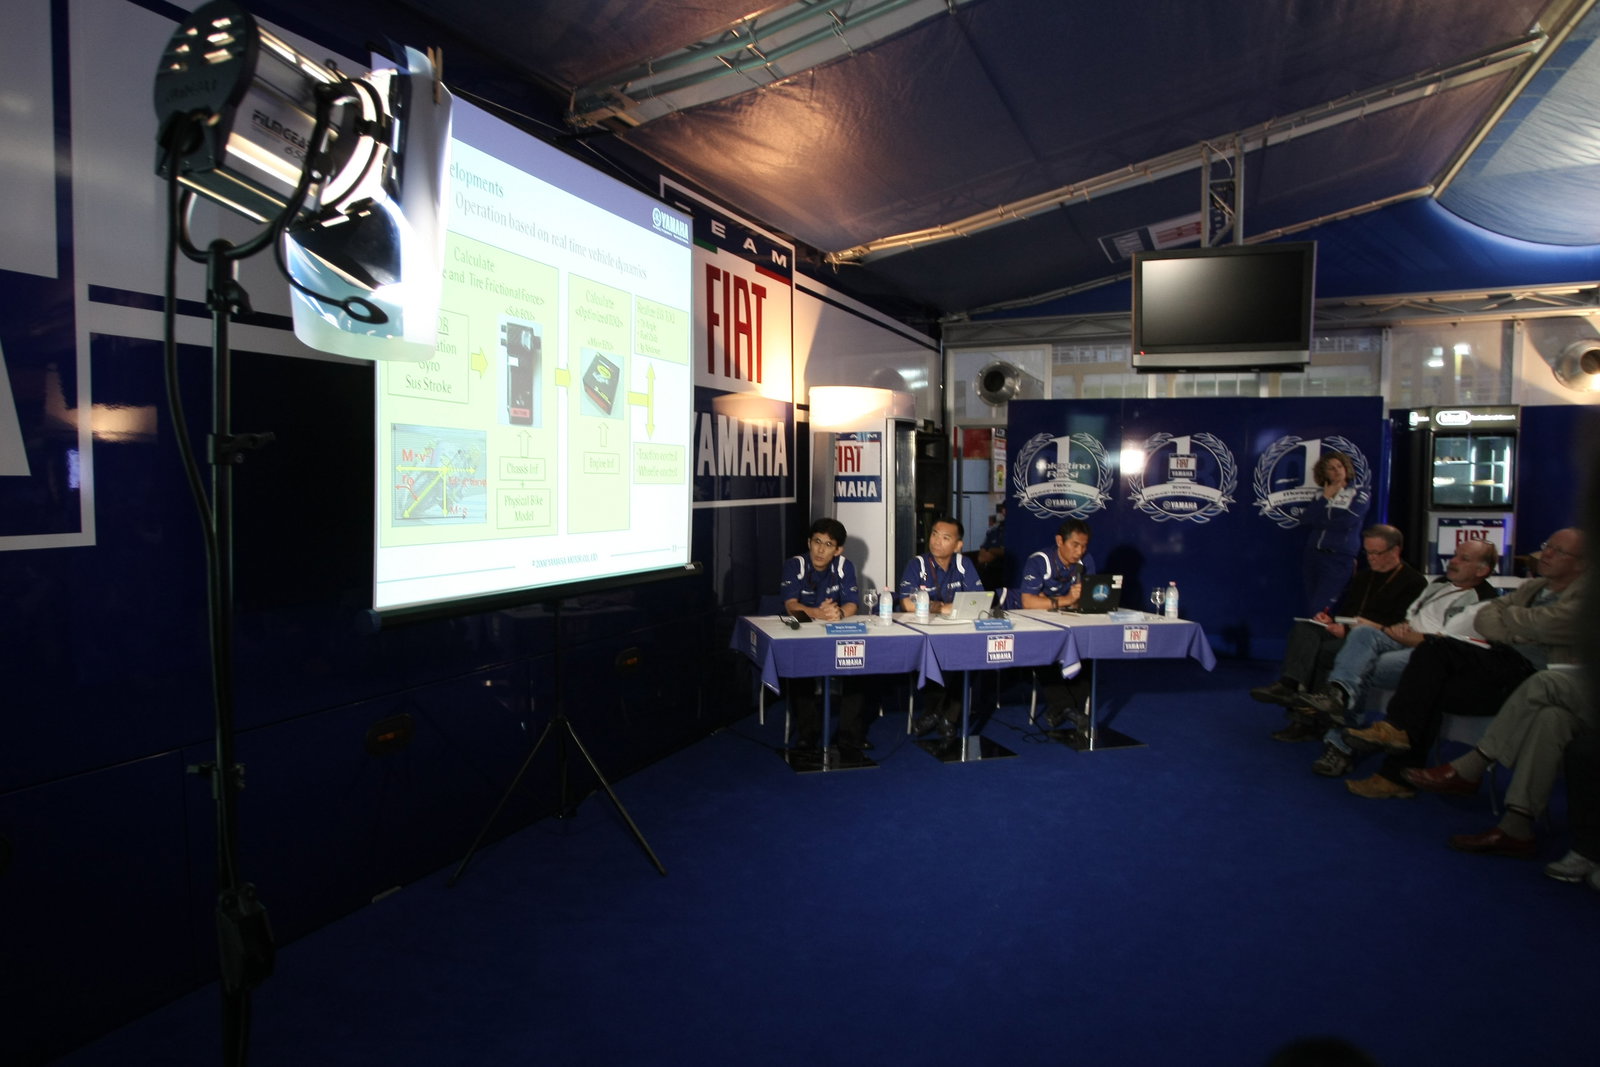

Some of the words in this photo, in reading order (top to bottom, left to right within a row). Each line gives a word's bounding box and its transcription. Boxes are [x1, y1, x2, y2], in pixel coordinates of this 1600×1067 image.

[251, 109, 311, 151] FILMGEA
[284, 146, 306, 161] 65
[455, 191, 507, 227] Operation
[508, 212, 536, 238] based
[537, 228, 549, 243] on
[551, 231, 567, 250] real
[569, 238, 588, 258] time
[588, 247, 616, 269] vehicle
[615, 256, 648, 281] dynamics
[661, 211, 689, 240] YAMAHA
[675, 201, 787, 268] EAM
[453, 246, 496, 273] Calculate
[448, 270, 465, 284] and
[468, 272, 484, 290] Tire
[485, 277, 521, 301] Frictional
[521, 288, 545, 306] Forces
[706, 263, 766, 384] FIAT
[418, 359, 441, 374] Gyro
[405, 373, 421, 391] Sus
[422, 376, 452, 394] Stroke
[835, 445, 863, 473] IAT
[1052, 499, 1078, 507] YAMAHA
[1171, 501, 1198, 510] YAMAHA
[838, 658, 863, 666] YAMAHA
[844, 646, 857, 657] FIAT
